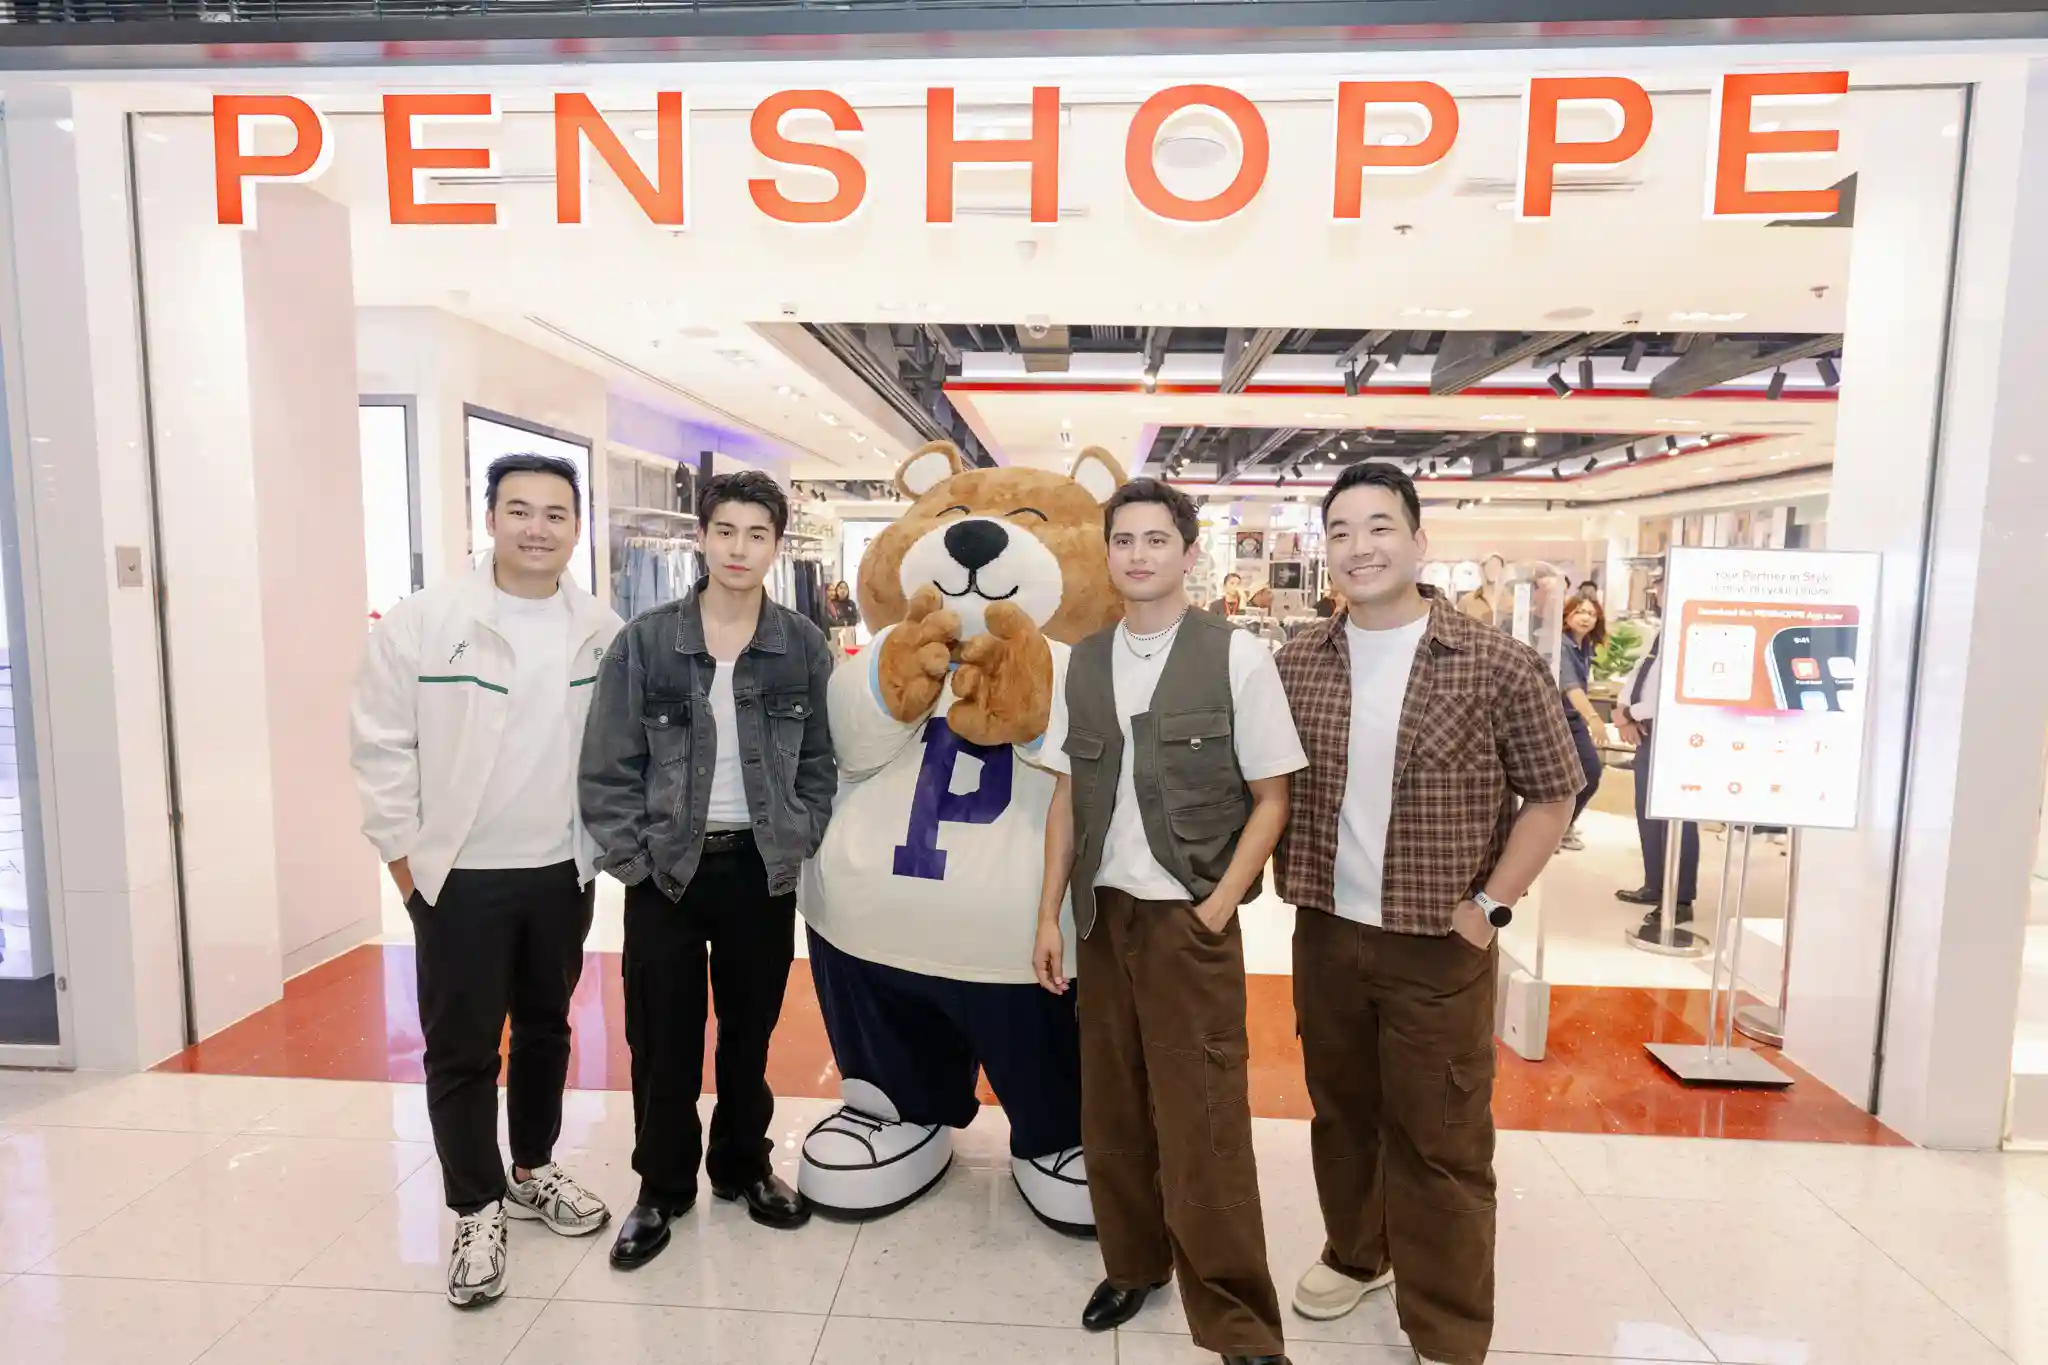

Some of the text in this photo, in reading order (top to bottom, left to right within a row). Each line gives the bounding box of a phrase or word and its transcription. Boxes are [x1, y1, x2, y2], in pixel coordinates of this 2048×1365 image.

[212, 70, 1849, 225] PENSHOPPE
[1742, 569, 1785, 582] Partner
[1788, 571, 1801, 582] in
[892, 717, 1013, 880] P
